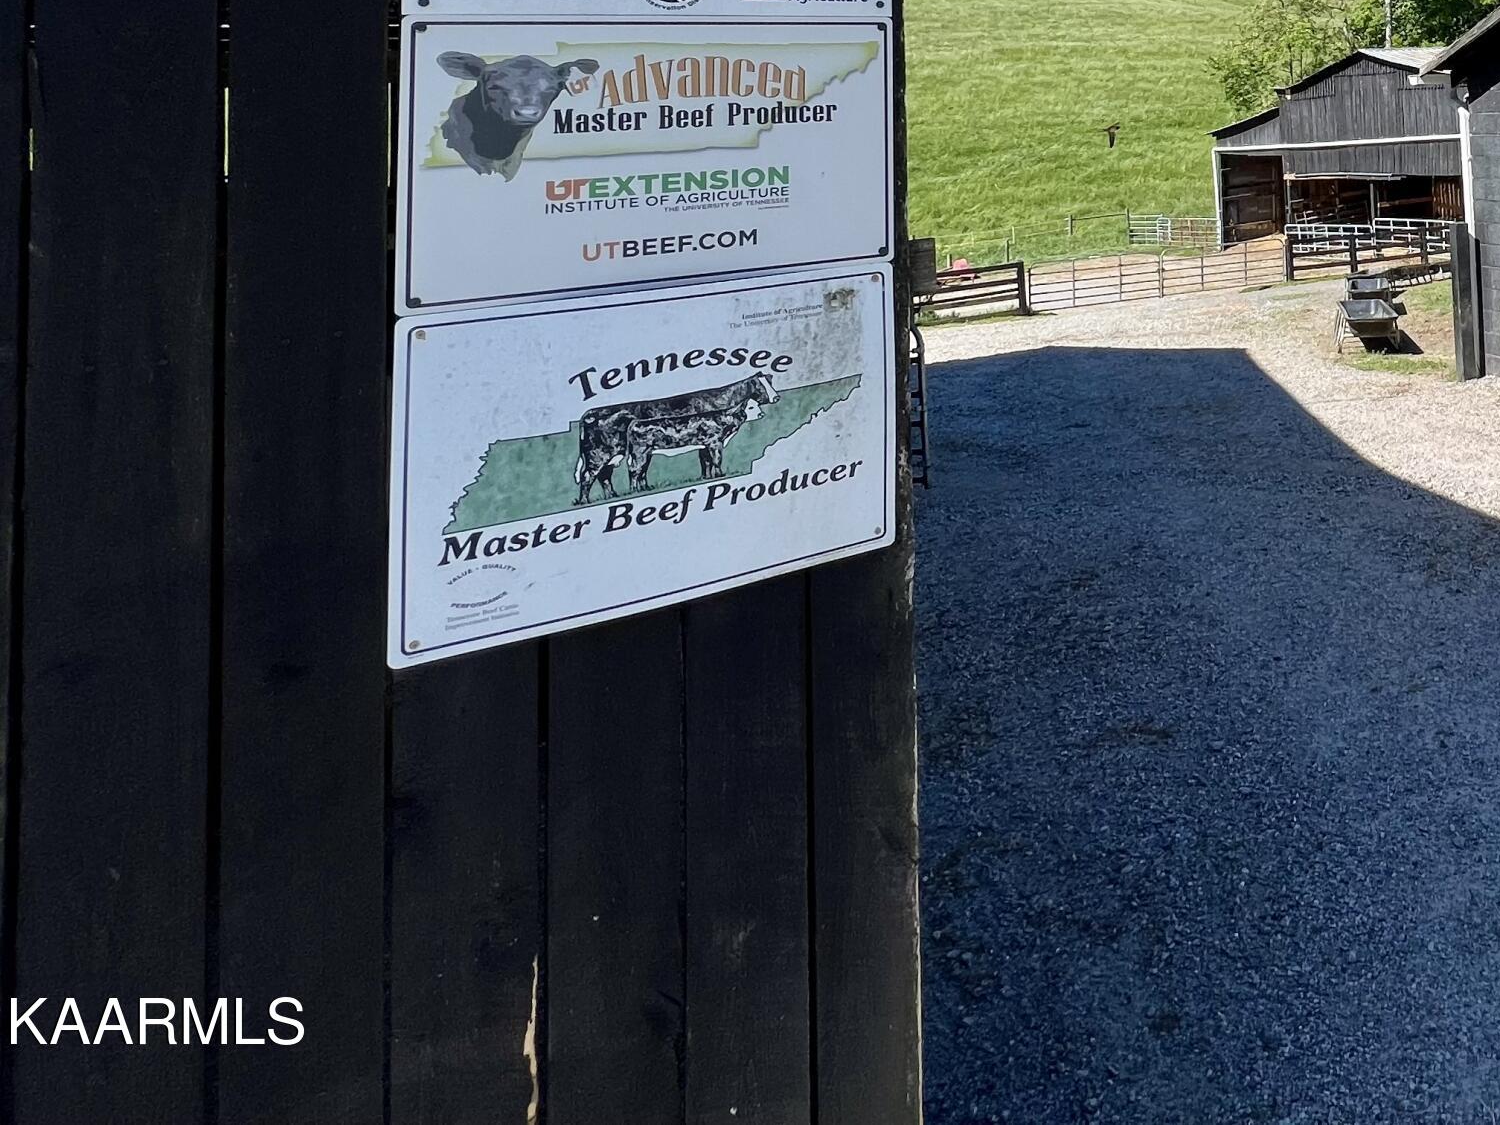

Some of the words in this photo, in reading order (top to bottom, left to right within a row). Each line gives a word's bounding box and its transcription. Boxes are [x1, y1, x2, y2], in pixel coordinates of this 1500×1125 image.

[599, 54, 807, 110] Advanced
[553, 106, 647, 135] Master
[658, 103, 714, 130] Beef
[728, 101, 837, 127] Producer
[545, 197, 640, 215] INSTITUTE
[645, 195, 670, 207] OF
[676, 186, 789, 204] AGRICULTURE
[664, 205, 681, 213] THE
[682, 201, 729, 212] UNIVERSITY
[746, 197, 789, 207] TENNESSEE
[583, 229, 758, 262] UTBEEF.COM
[569, 346, 793, 402] Tennessee
[437, 519, 591, 566] Master
[603, 489, 697, 534] Beef
[703, 458, 863, 512] Producer
